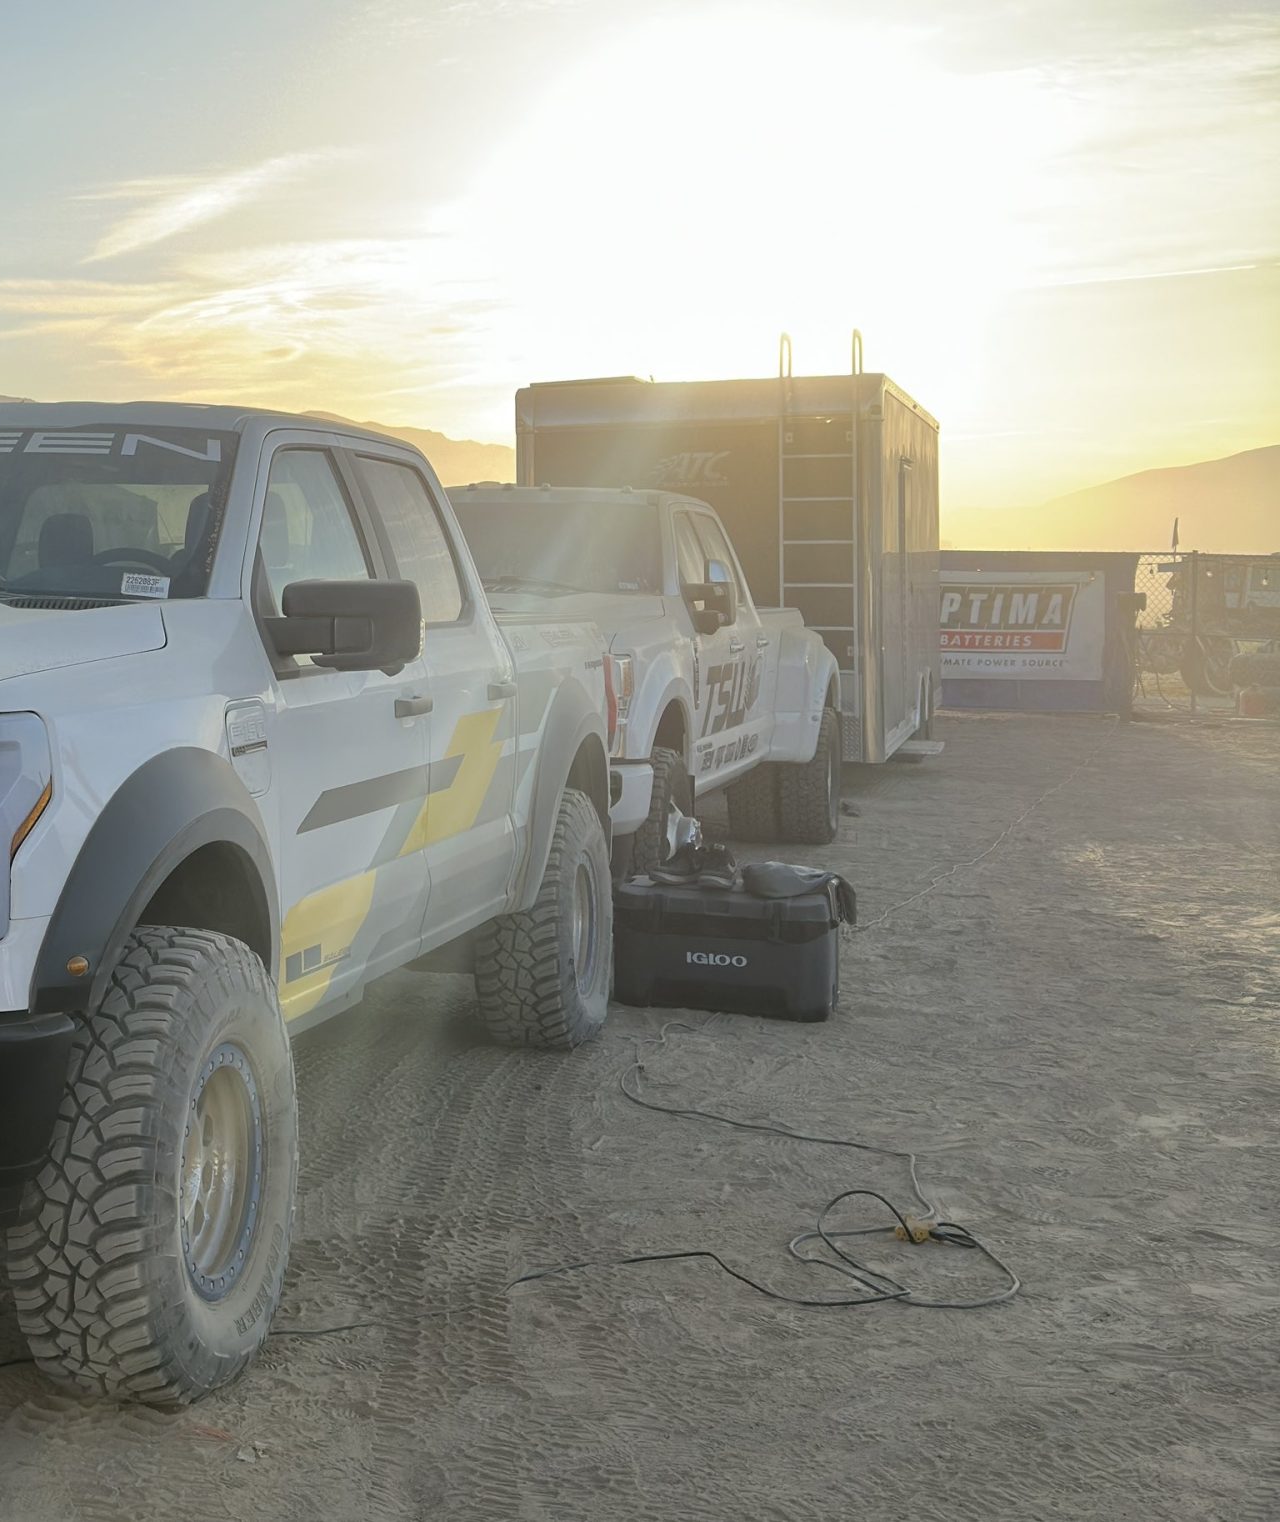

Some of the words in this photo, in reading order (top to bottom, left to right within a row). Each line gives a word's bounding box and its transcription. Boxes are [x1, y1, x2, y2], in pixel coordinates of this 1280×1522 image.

[940, 592, 1064, 625] PTIMA
[940, 634, 1033, 647] BATTERIES
[939, 659, 972, 668] MATE
[977, 659, 1016, 668] POWER
[686, 951, 748, 967] IGLOO
